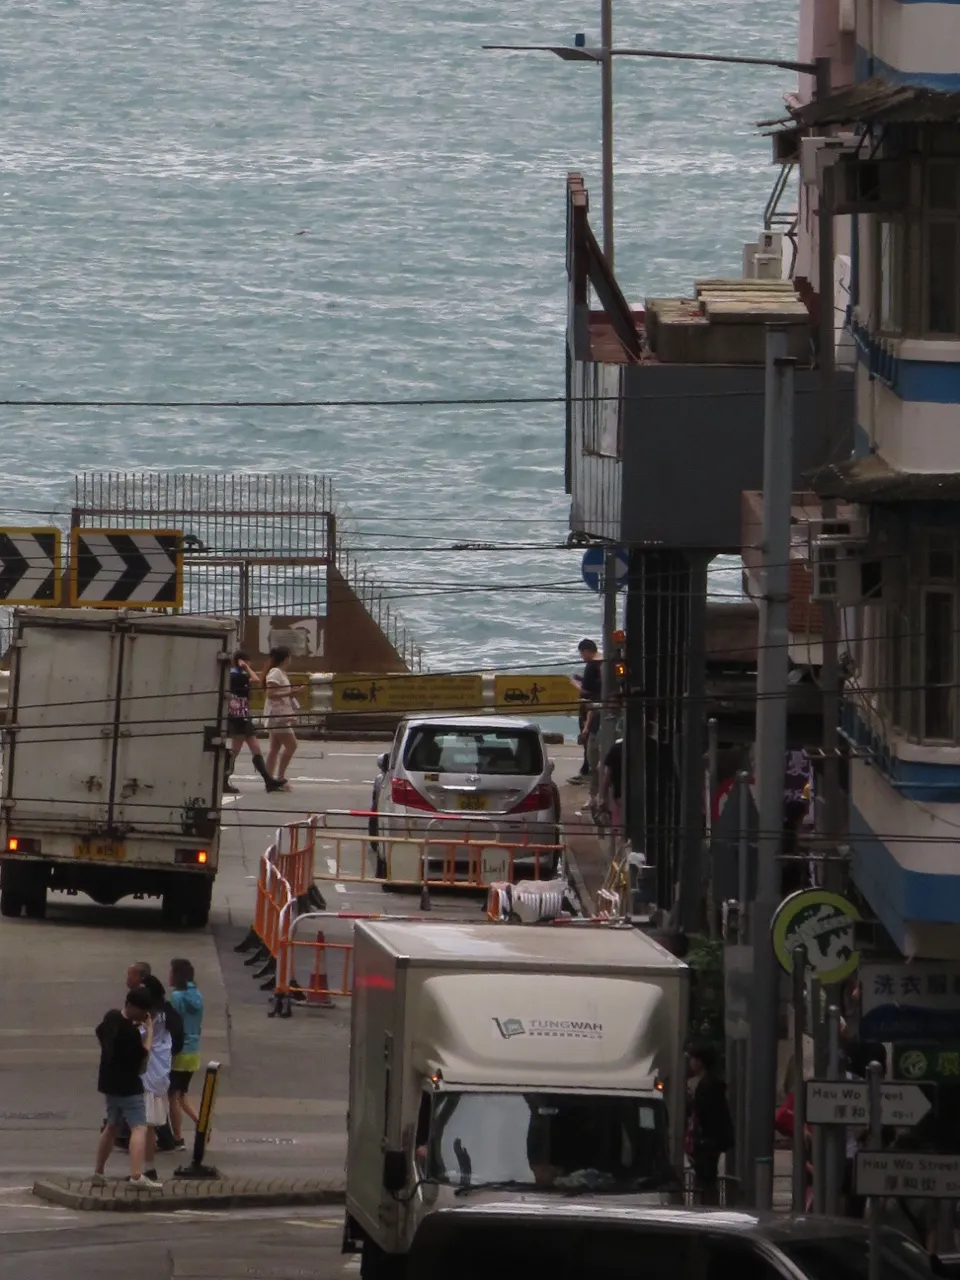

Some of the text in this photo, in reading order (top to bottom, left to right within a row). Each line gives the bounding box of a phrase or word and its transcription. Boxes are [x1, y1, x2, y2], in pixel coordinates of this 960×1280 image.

[530, 1020, 603, 1031] TUNGWAH
[812, 1088, 838, 1100] Hau
[842, 1089, 861, 1100] Wo
[863, 1158, 959, 1170] Hau Wo Street
